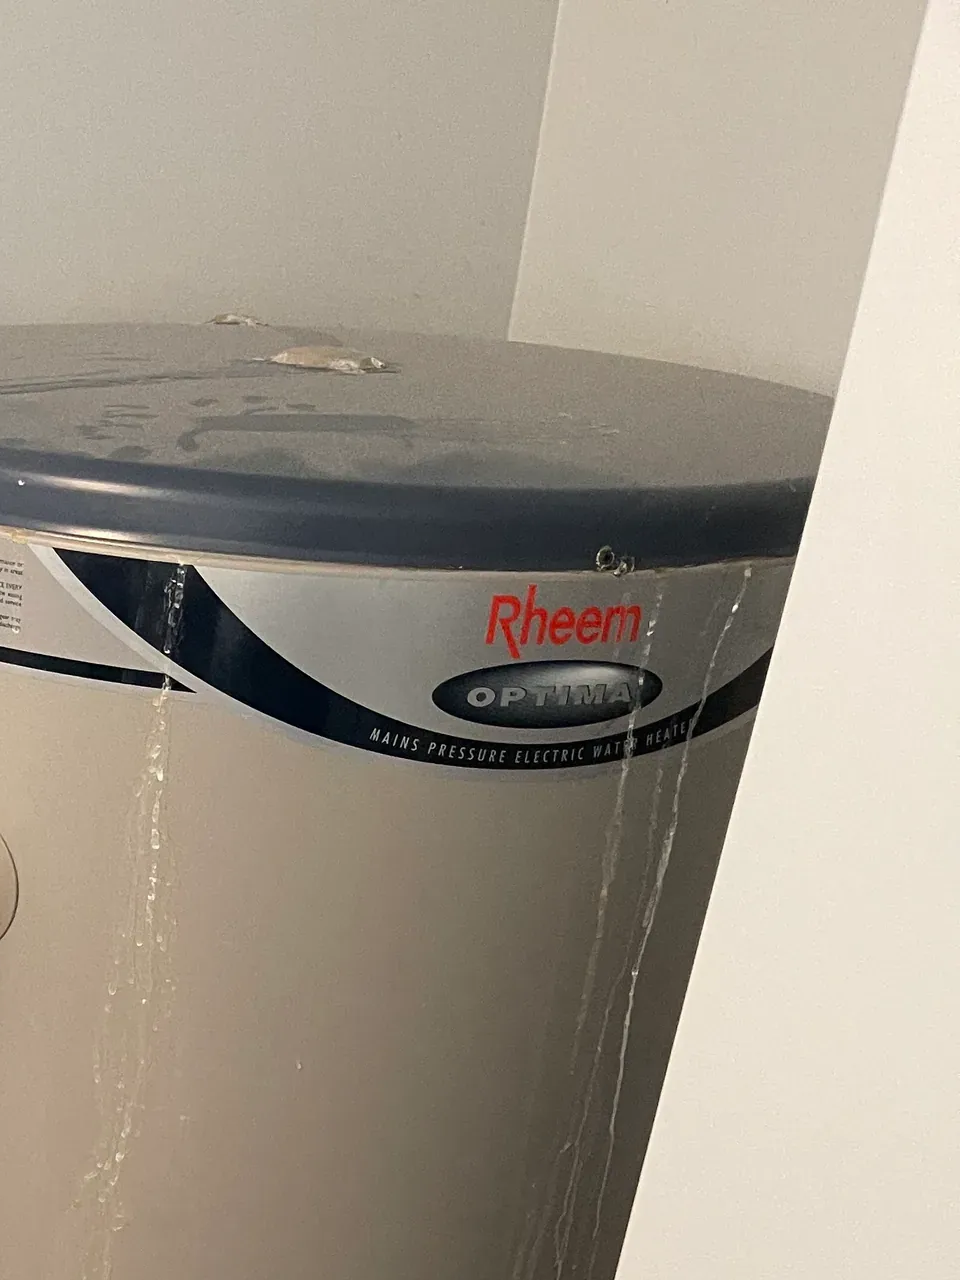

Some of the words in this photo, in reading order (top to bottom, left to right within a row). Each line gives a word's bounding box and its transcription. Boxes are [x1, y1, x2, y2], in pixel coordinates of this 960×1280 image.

[6, 583, 22, 591] EVERY
[485, 584, 642, 659] Rheem
[467, 682, 631, 708] OPTIMA
[369, 728, 420, 751] MAINS
[427, 741, 507, 763] PRESSURE
[514, 747, 584, 764] ELECTRIC
